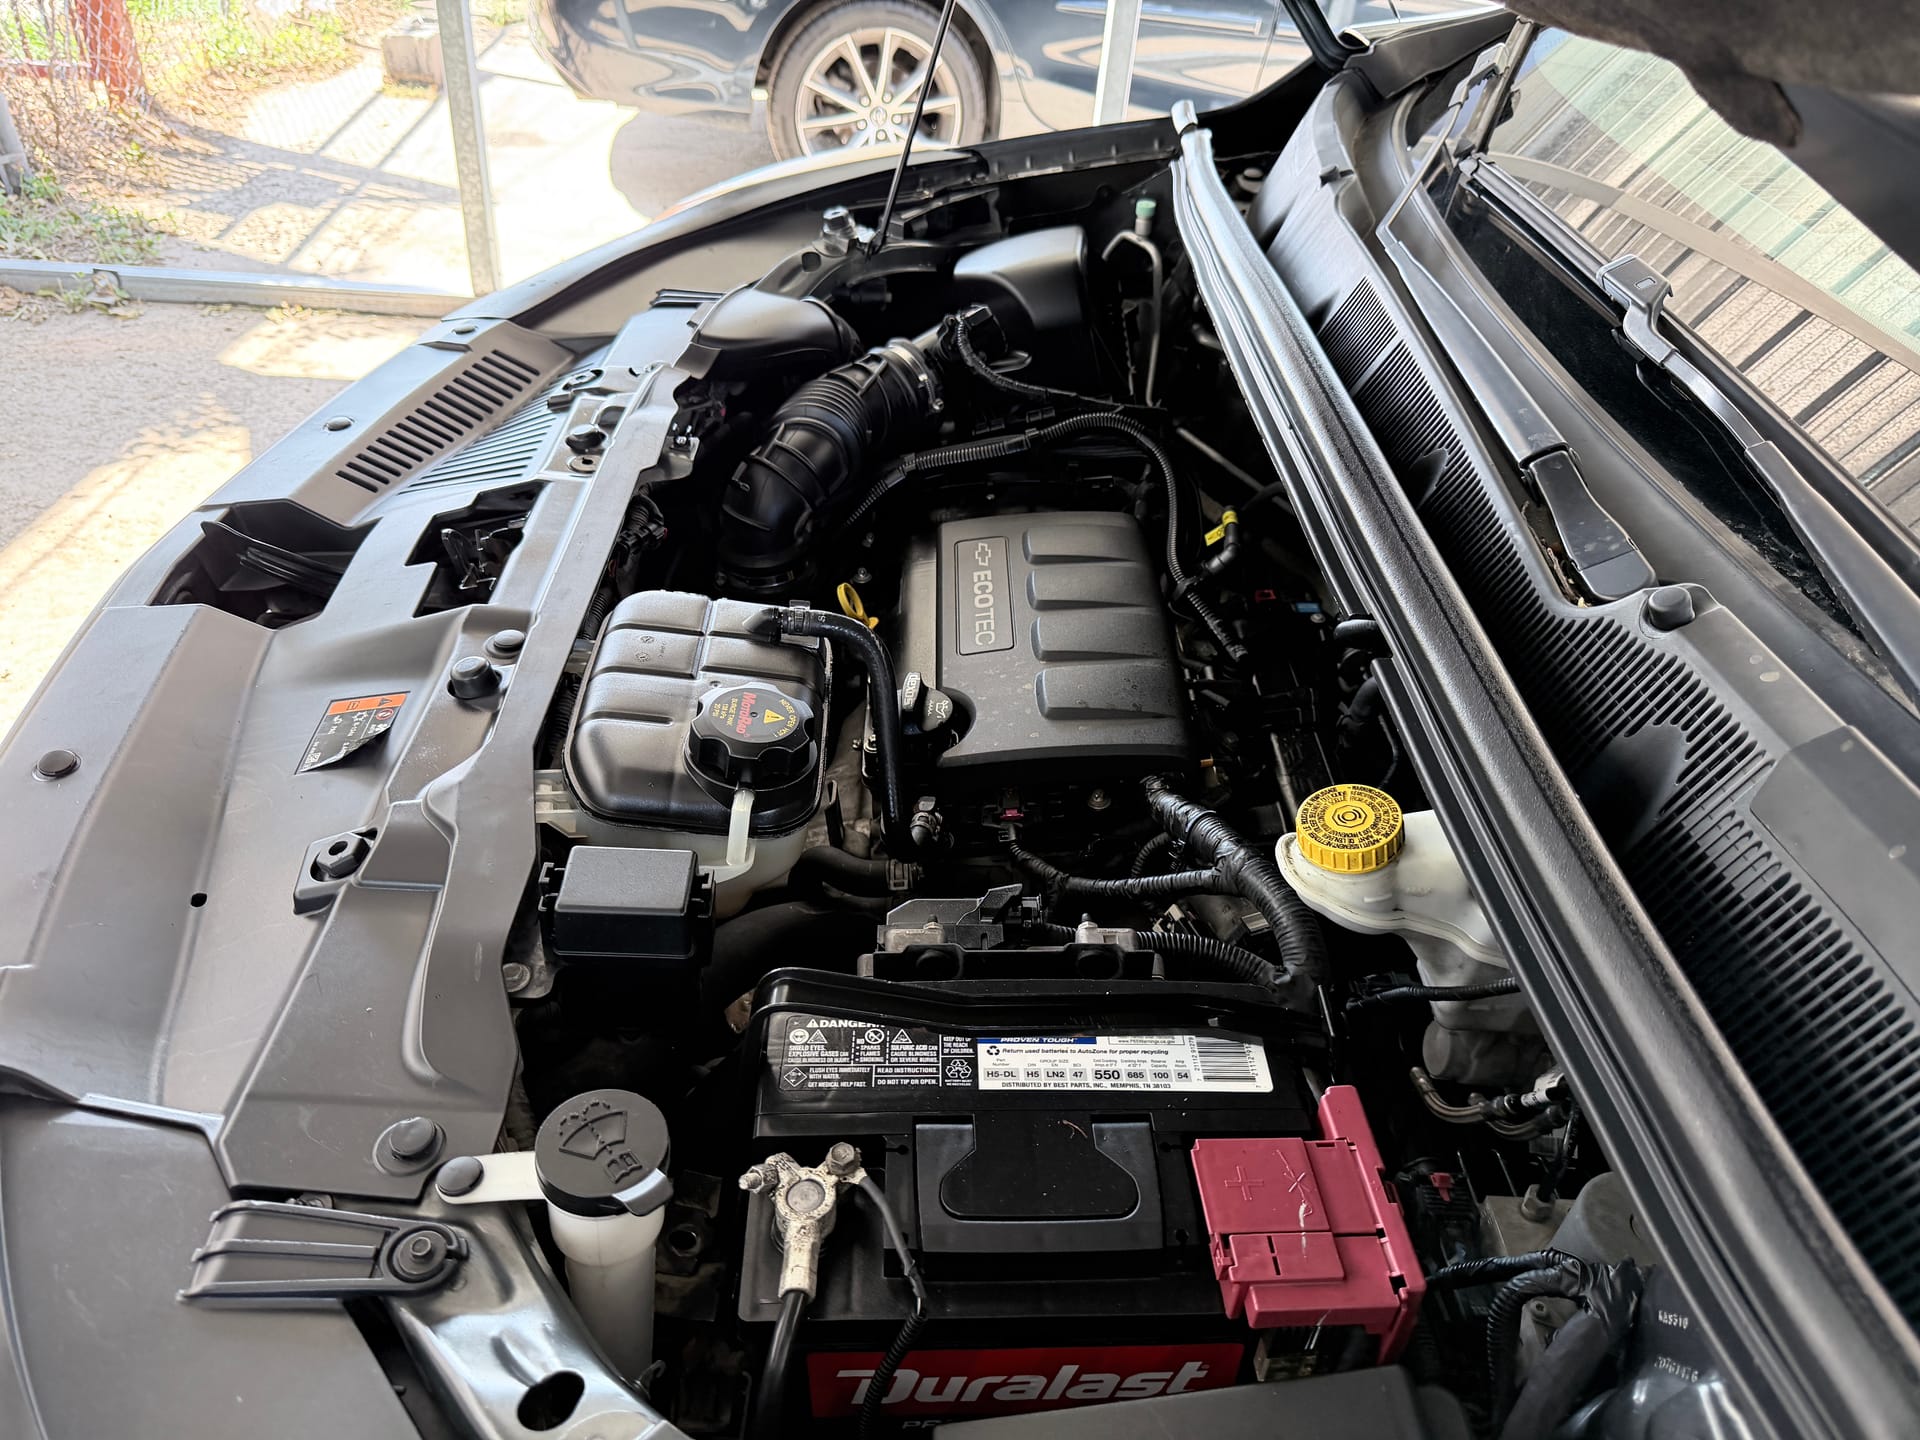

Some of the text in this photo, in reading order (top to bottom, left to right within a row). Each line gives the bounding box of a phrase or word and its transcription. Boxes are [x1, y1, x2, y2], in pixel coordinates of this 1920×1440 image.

[973, 570, 995, 645] ECOTEC
[1140, 1048, 1169, 1056] recycling
[986, 1070, 1017, 1078] H5-DL
[1026, 1070, 1040, 1078] H5
[1046, 1070, 1065, 1078] LN2
[1094, 1069, 1121, 1080] 550
[1127, 1071, 1145, 1079] 685
[1153, 1071, 1169, 1079] 100
[1177, 1071, 1189, 1079] 54
[836, 1361, 1209, 1404] Duralast
